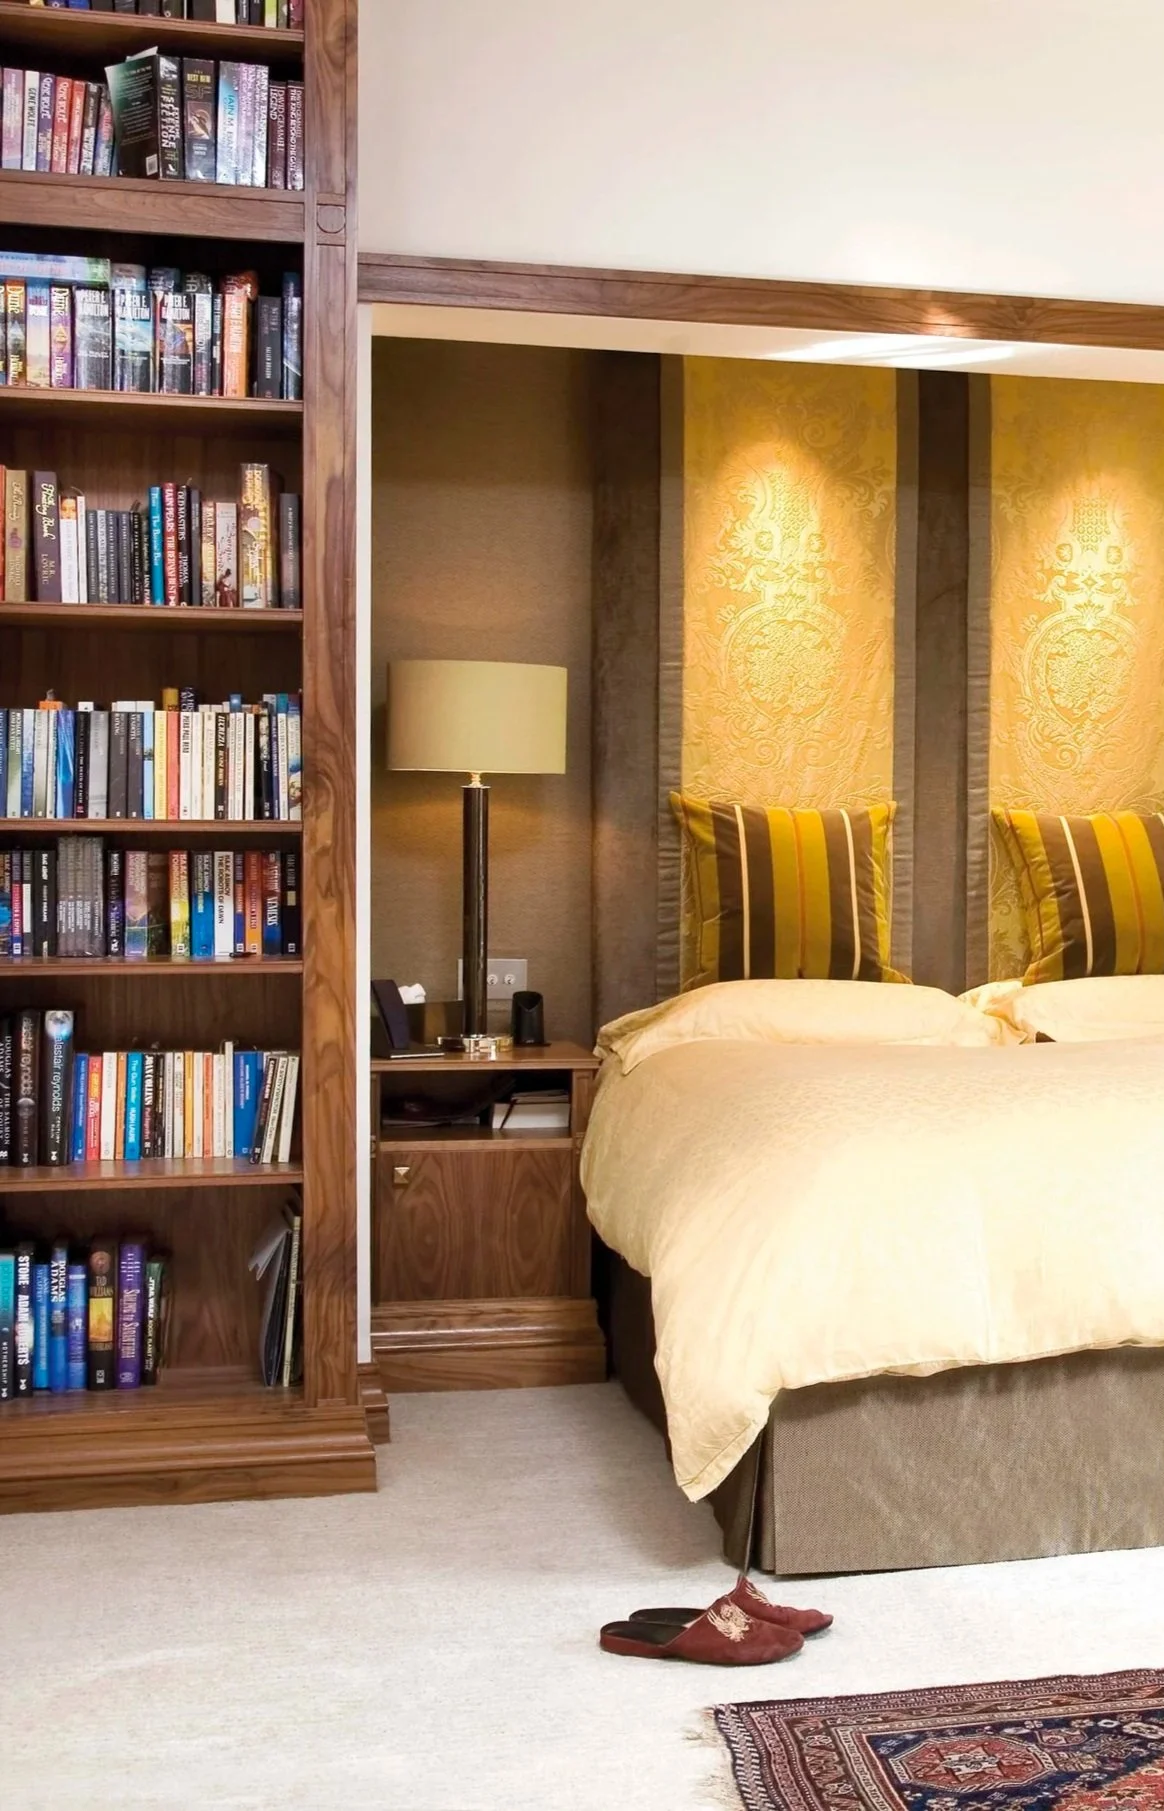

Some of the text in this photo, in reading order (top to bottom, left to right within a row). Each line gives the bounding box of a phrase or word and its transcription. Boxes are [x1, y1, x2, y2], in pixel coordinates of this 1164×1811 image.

[28, 87, 37, 128] GENE WOLFE
[160, 95, 169, 149] FICTION
[168, 96, 177, 149] SCIENCE
[227, 94, 235, 115] IAIN
[270, 88, 278, 120] LEGEND
[276, 89, 285, 152] DAVID GEMMELL
[42, 516, 56, 540] Book
[166, 507, 175, 532] PEARS
[177, 491, 187, 541] OLD MASTERS
[41, 553, 49, 585] LOVRIC
[217, 856, 225, 924] THE ROBOTS OF DAWN
[266, 896, 279, 927] NEMESIS
[20, 1016, 34, 1096] alastair reynolds
[51, 1037, 64, 1113] alastair reynolds
[131, 1059, 139, 1071] The
[144, 1055, 154, 1106] JOAN COLLINS
[18, 1255, 30, 1286] STONE
[50, 1260, 59, 1303] ADAMS
[58, 1260, 67, 1303] DOUGLAS
[18, 1294, 30, 1320] ADAM
